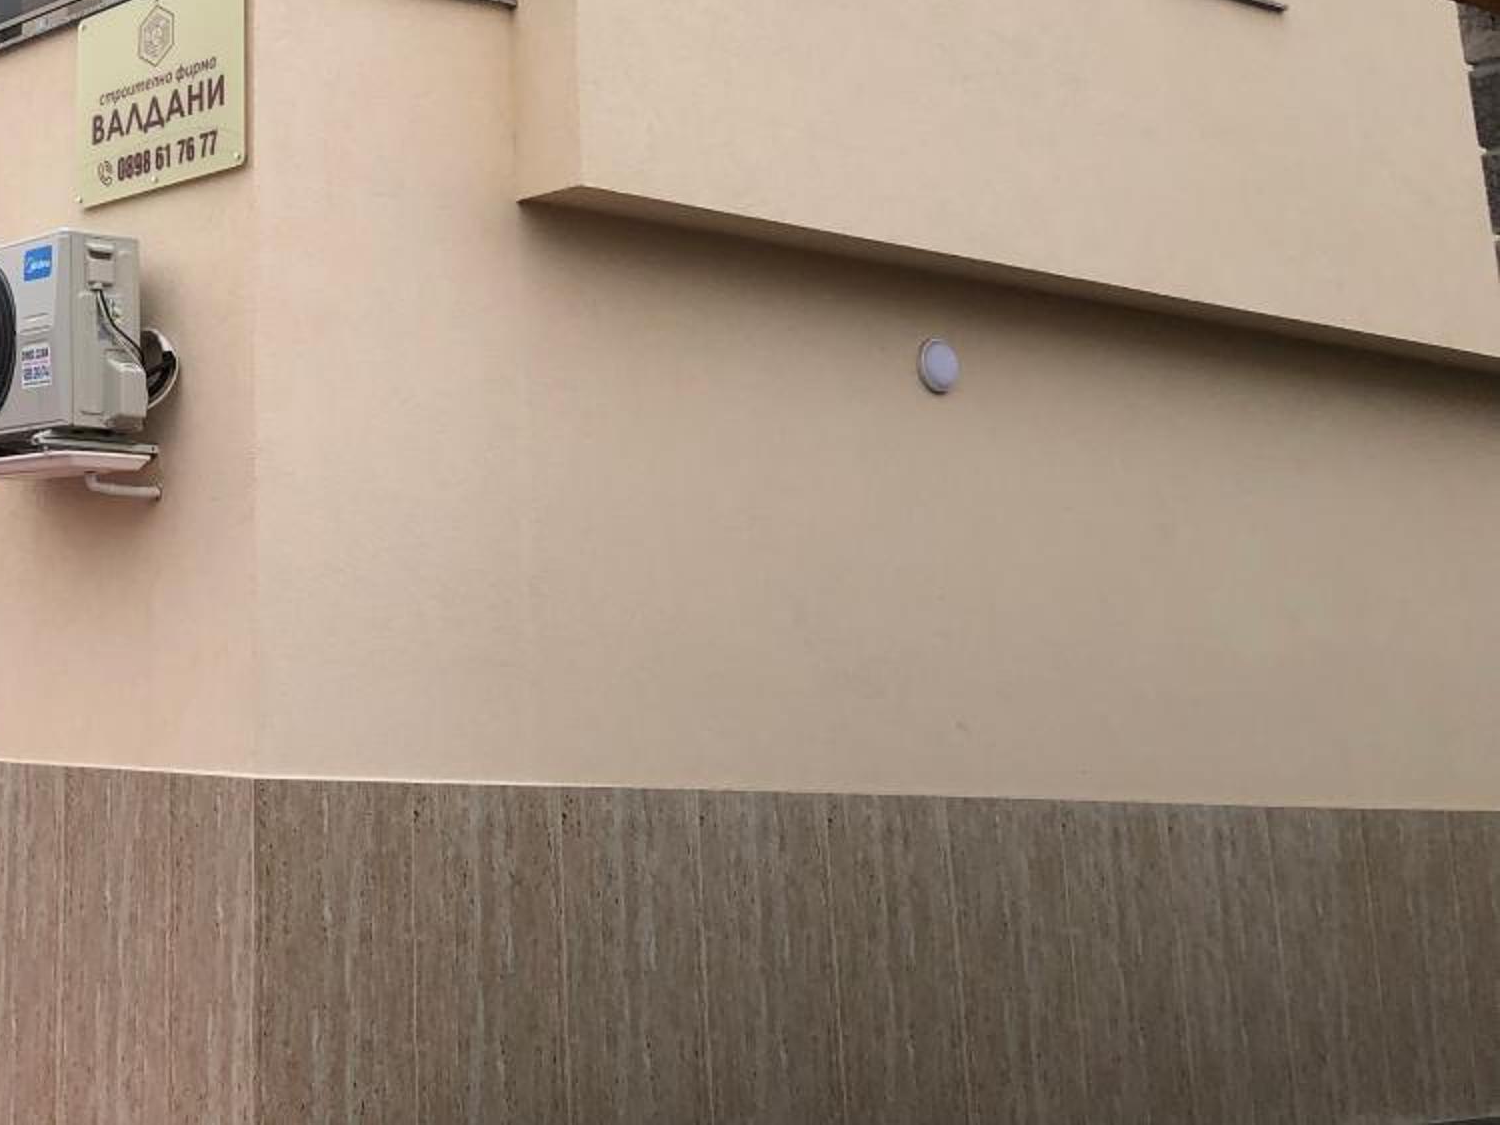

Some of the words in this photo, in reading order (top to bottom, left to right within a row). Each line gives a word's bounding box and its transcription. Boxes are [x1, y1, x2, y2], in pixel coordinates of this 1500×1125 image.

[91, 74, 226, 145] ВАЛДАНИ
[117, 149, 151, 181] 0898
[155, 142, 171, 172] 61
[177, 136, 195, 165] 76
[200, 130, 218, 157] 77
